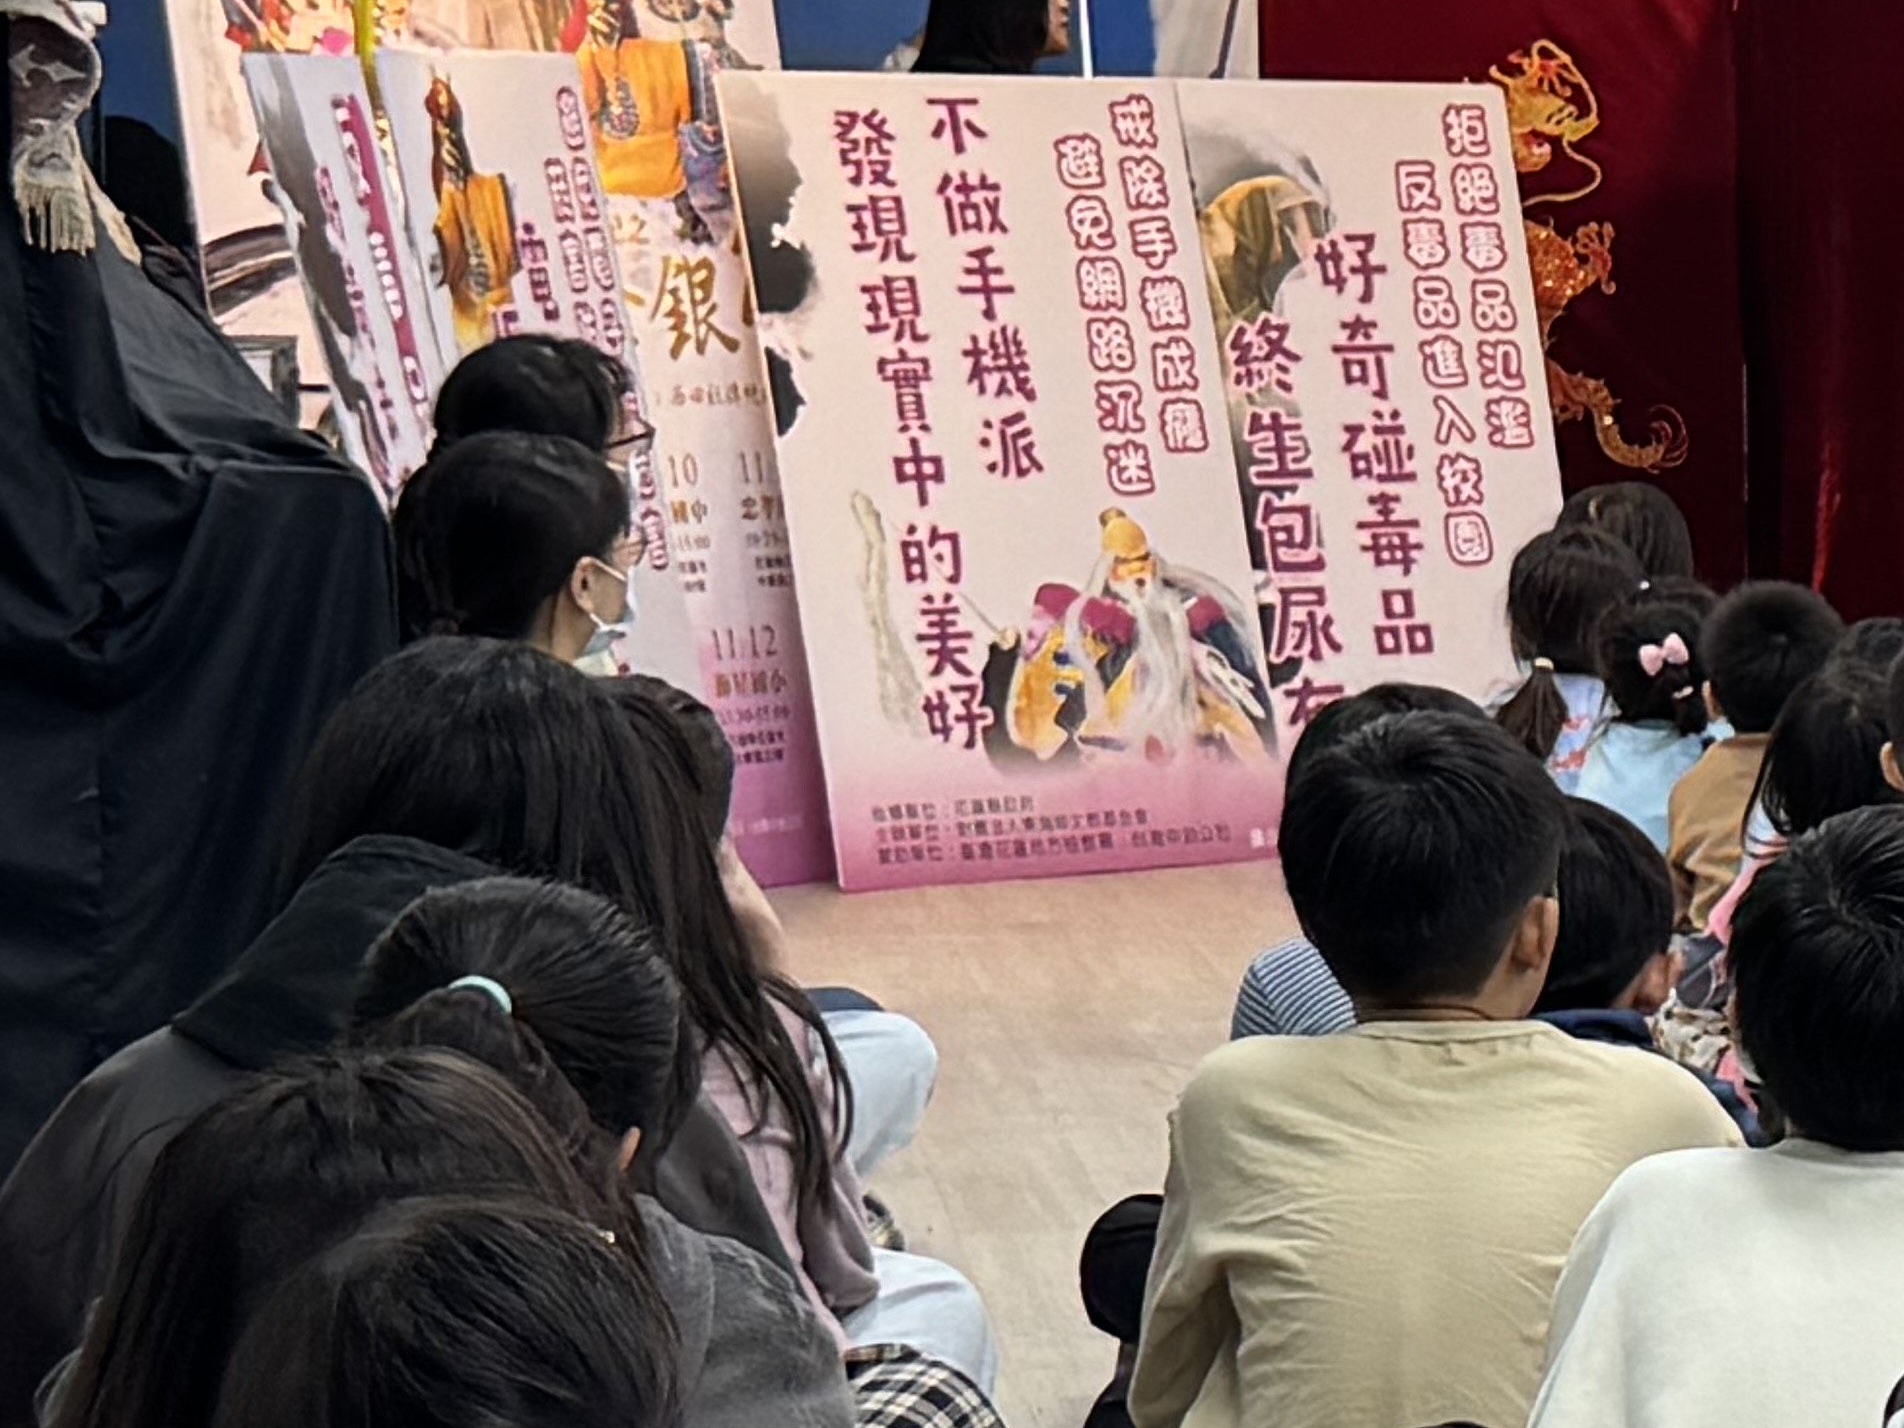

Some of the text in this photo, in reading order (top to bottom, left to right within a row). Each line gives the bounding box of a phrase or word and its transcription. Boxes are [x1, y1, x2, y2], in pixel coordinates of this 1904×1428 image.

[834, 108, 992, 751] 發現現實中的美好
[926, 98, 1045, 479] 不做手機派
[1054, 133, 1155, 497] 避免網路沉迷
[1109, 94, 1209, 454] 戒除手機成癮
[1313, 231, 1434, 657] 好奇碰毒品
[1395, 159, 1494, 568] 反毒品進入校園
